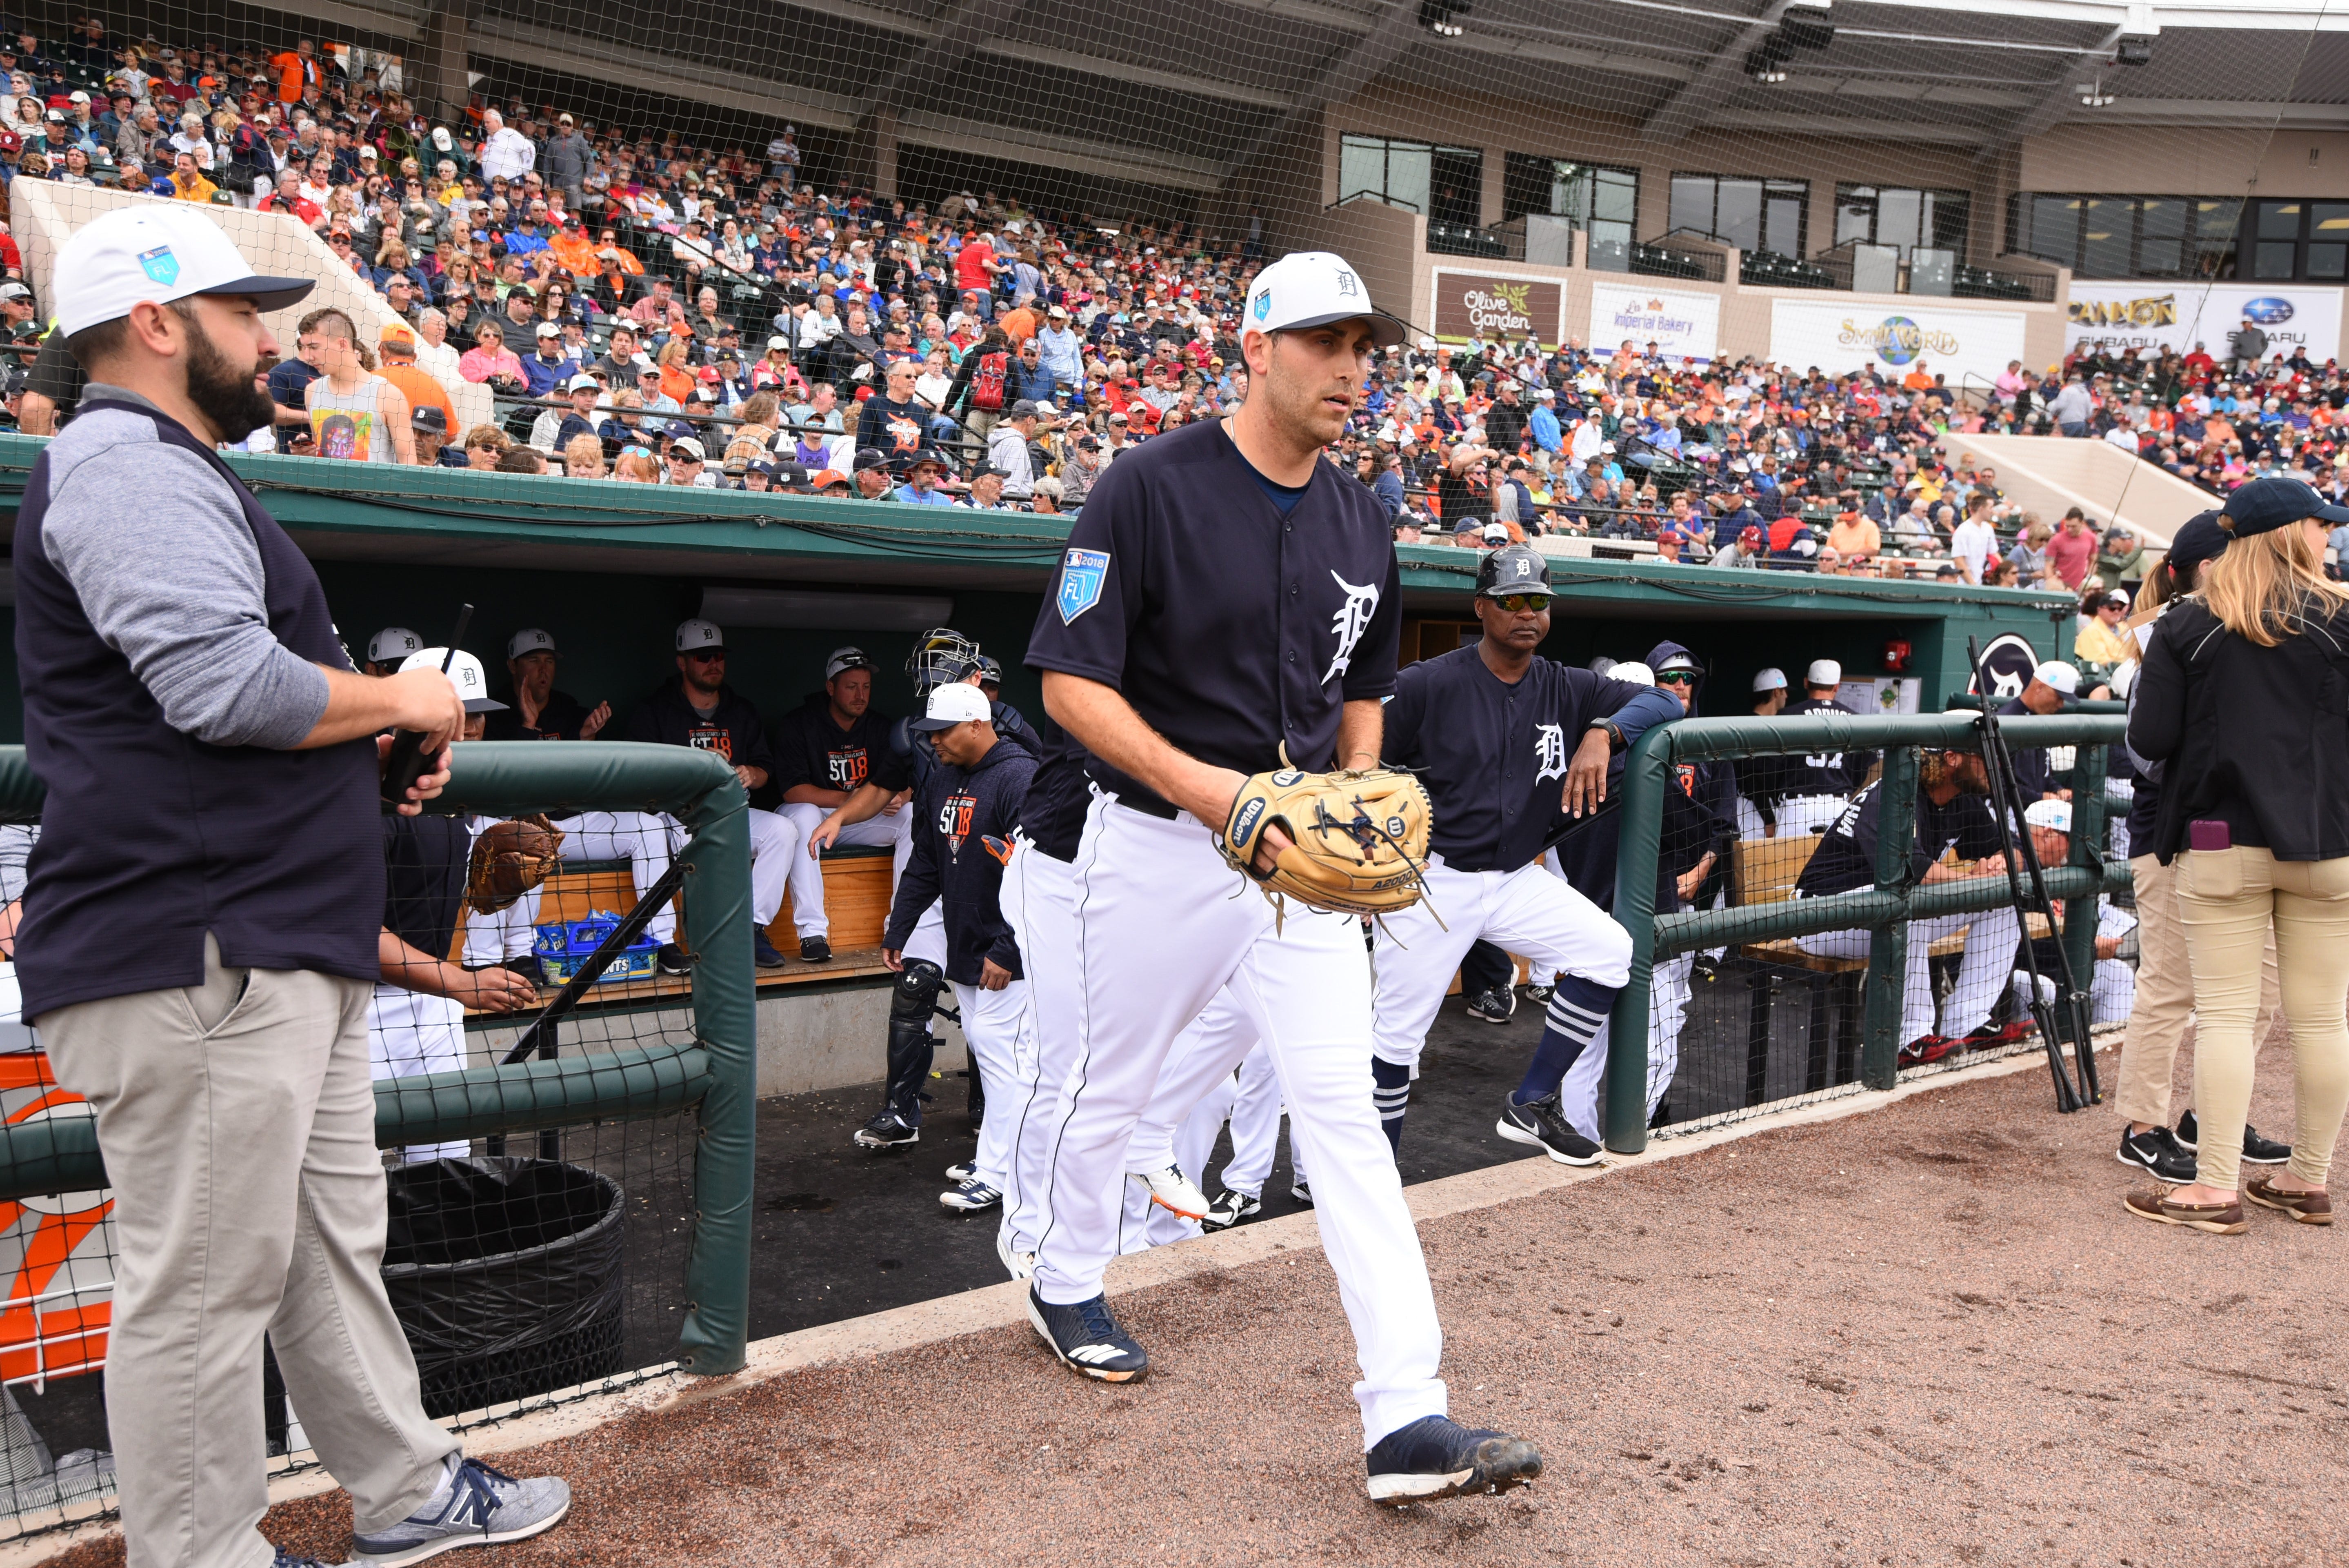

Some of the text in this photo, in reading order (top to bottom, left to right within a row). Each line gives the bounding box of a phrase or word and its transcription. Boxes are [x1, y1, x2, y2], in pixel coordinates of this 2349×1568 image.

[153, 265, 170, 277] FL
[1333, 267, 1358, 297] D
[1258, 304, 1266, 315] FL
[1464, 290, 1508, 311] Olive
[1470, 308, 1531, 331] Garden
[2067, 299, 2177, 325] CANNON
[1614, 313, 1693, 336] Imperial Bakery
[2227, 332, 2306, 344] SARU
[1082, 556, 1104, 568] 2018
[1516, 558, 1530, 578] D
[1064, 582, 1079, 600] FL
[702, 627, 713, 640] D
[1321, 569, 1379, 686] D
[403, 636, 416, 649] D
[535, 633, 546, 643] D
[460, 667, 477, 688] D
[1535, 722, 1568, 787] D
[829, 756, 867, 781] ST18
[1233, 800, 1264, 842] Wilson
[1371, 871, 1413, 890] A2000
